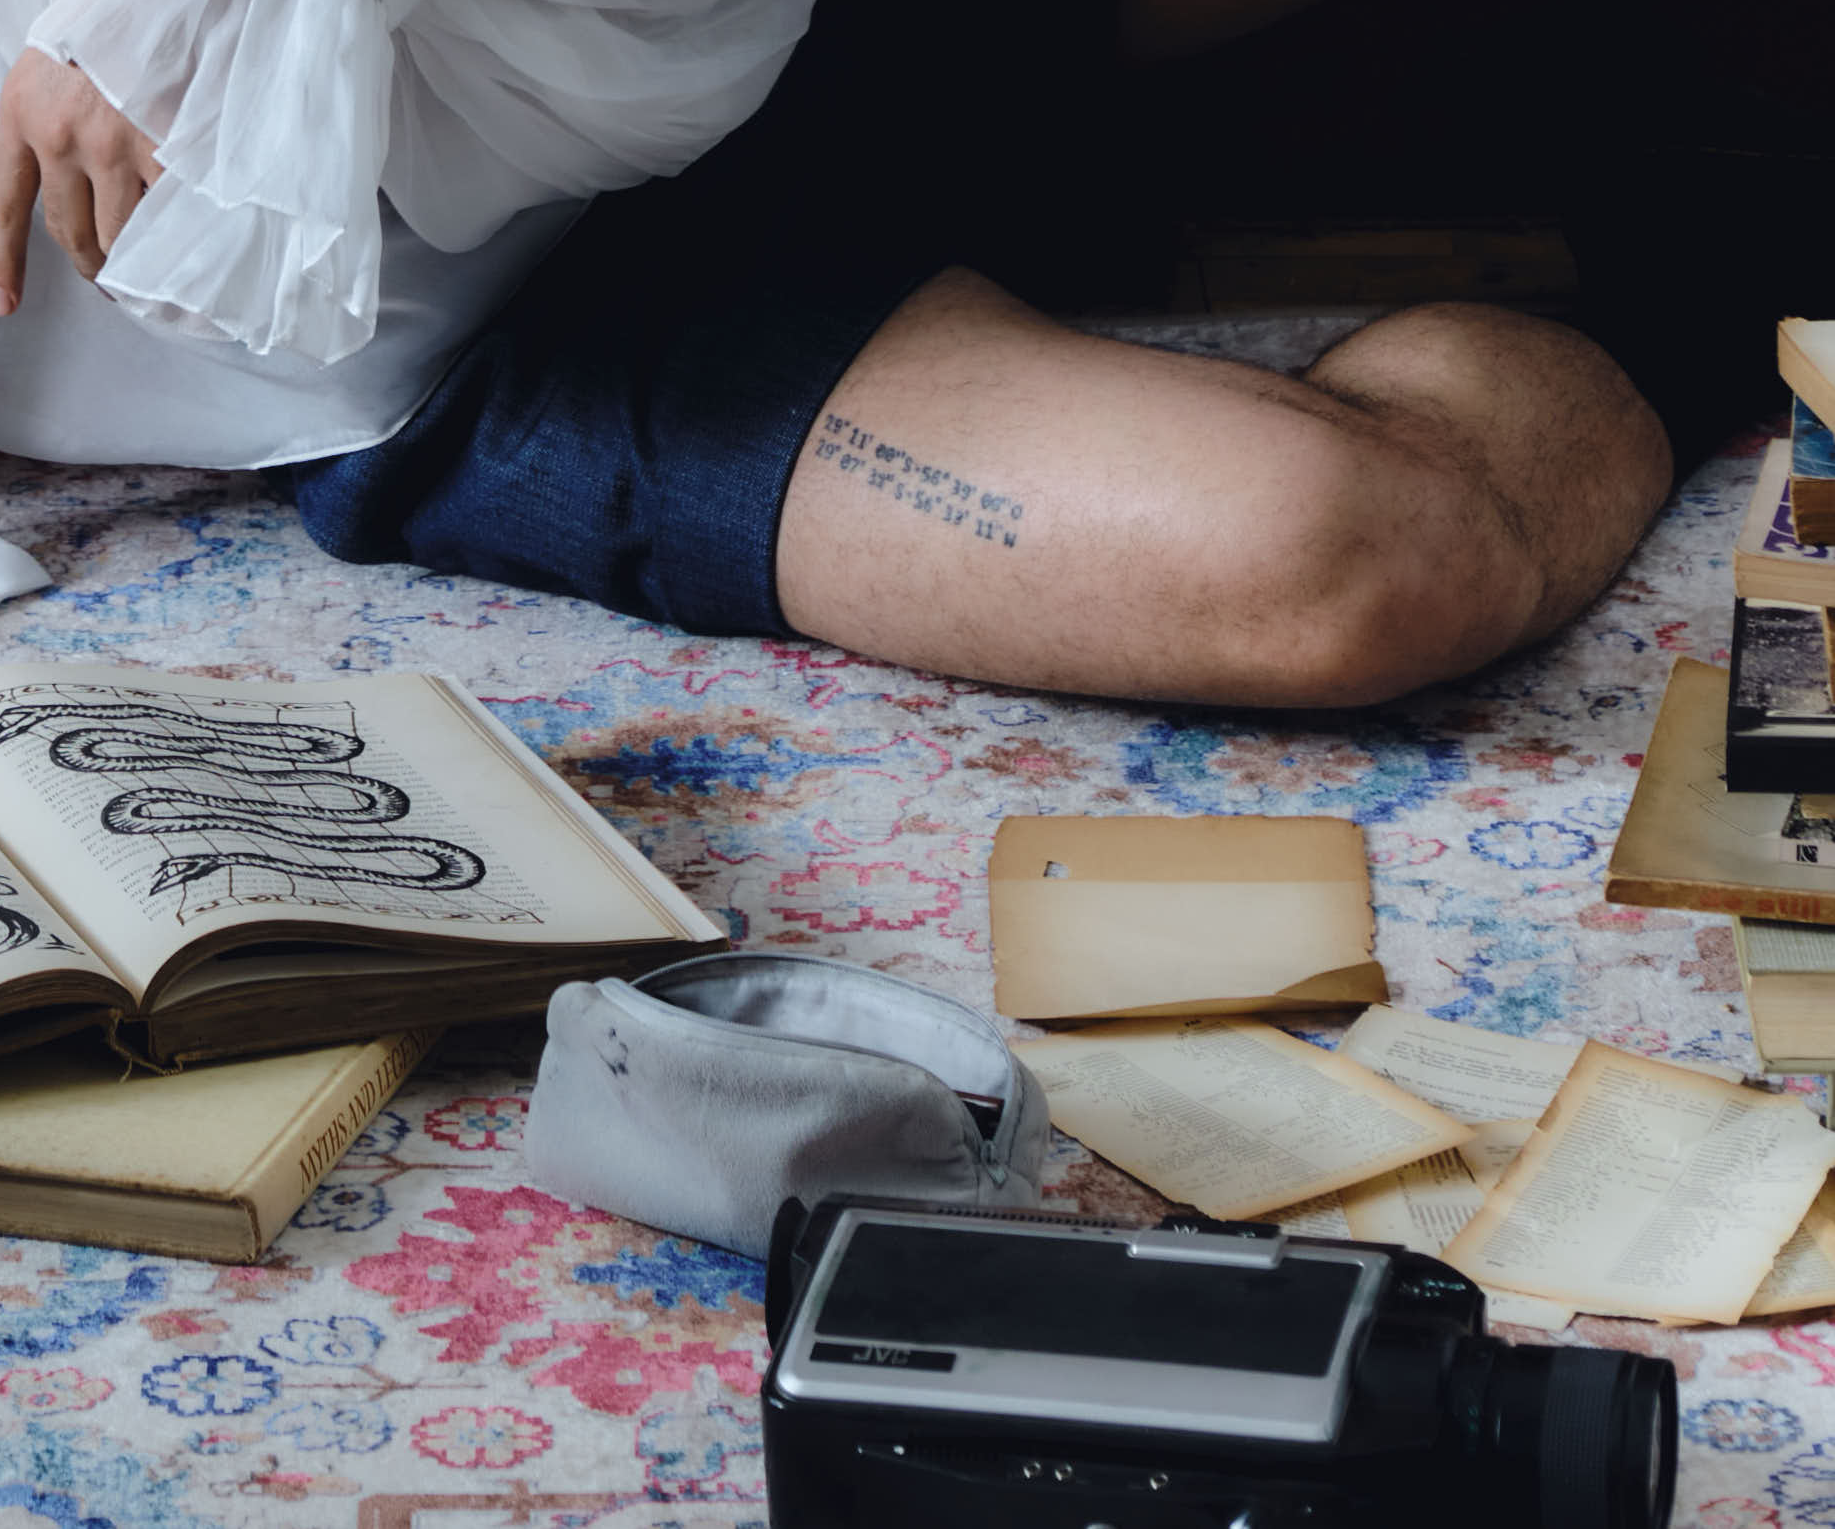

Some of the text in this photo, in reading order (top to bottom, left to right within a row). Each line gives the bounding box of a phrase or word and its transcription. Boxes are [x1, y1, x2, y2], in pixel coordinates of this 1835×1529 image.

[300, 1112, 348, 1194] MYTHS
[348, 1080, 376, 1135] AND
[851, 1346, 909, 1365] JVC
